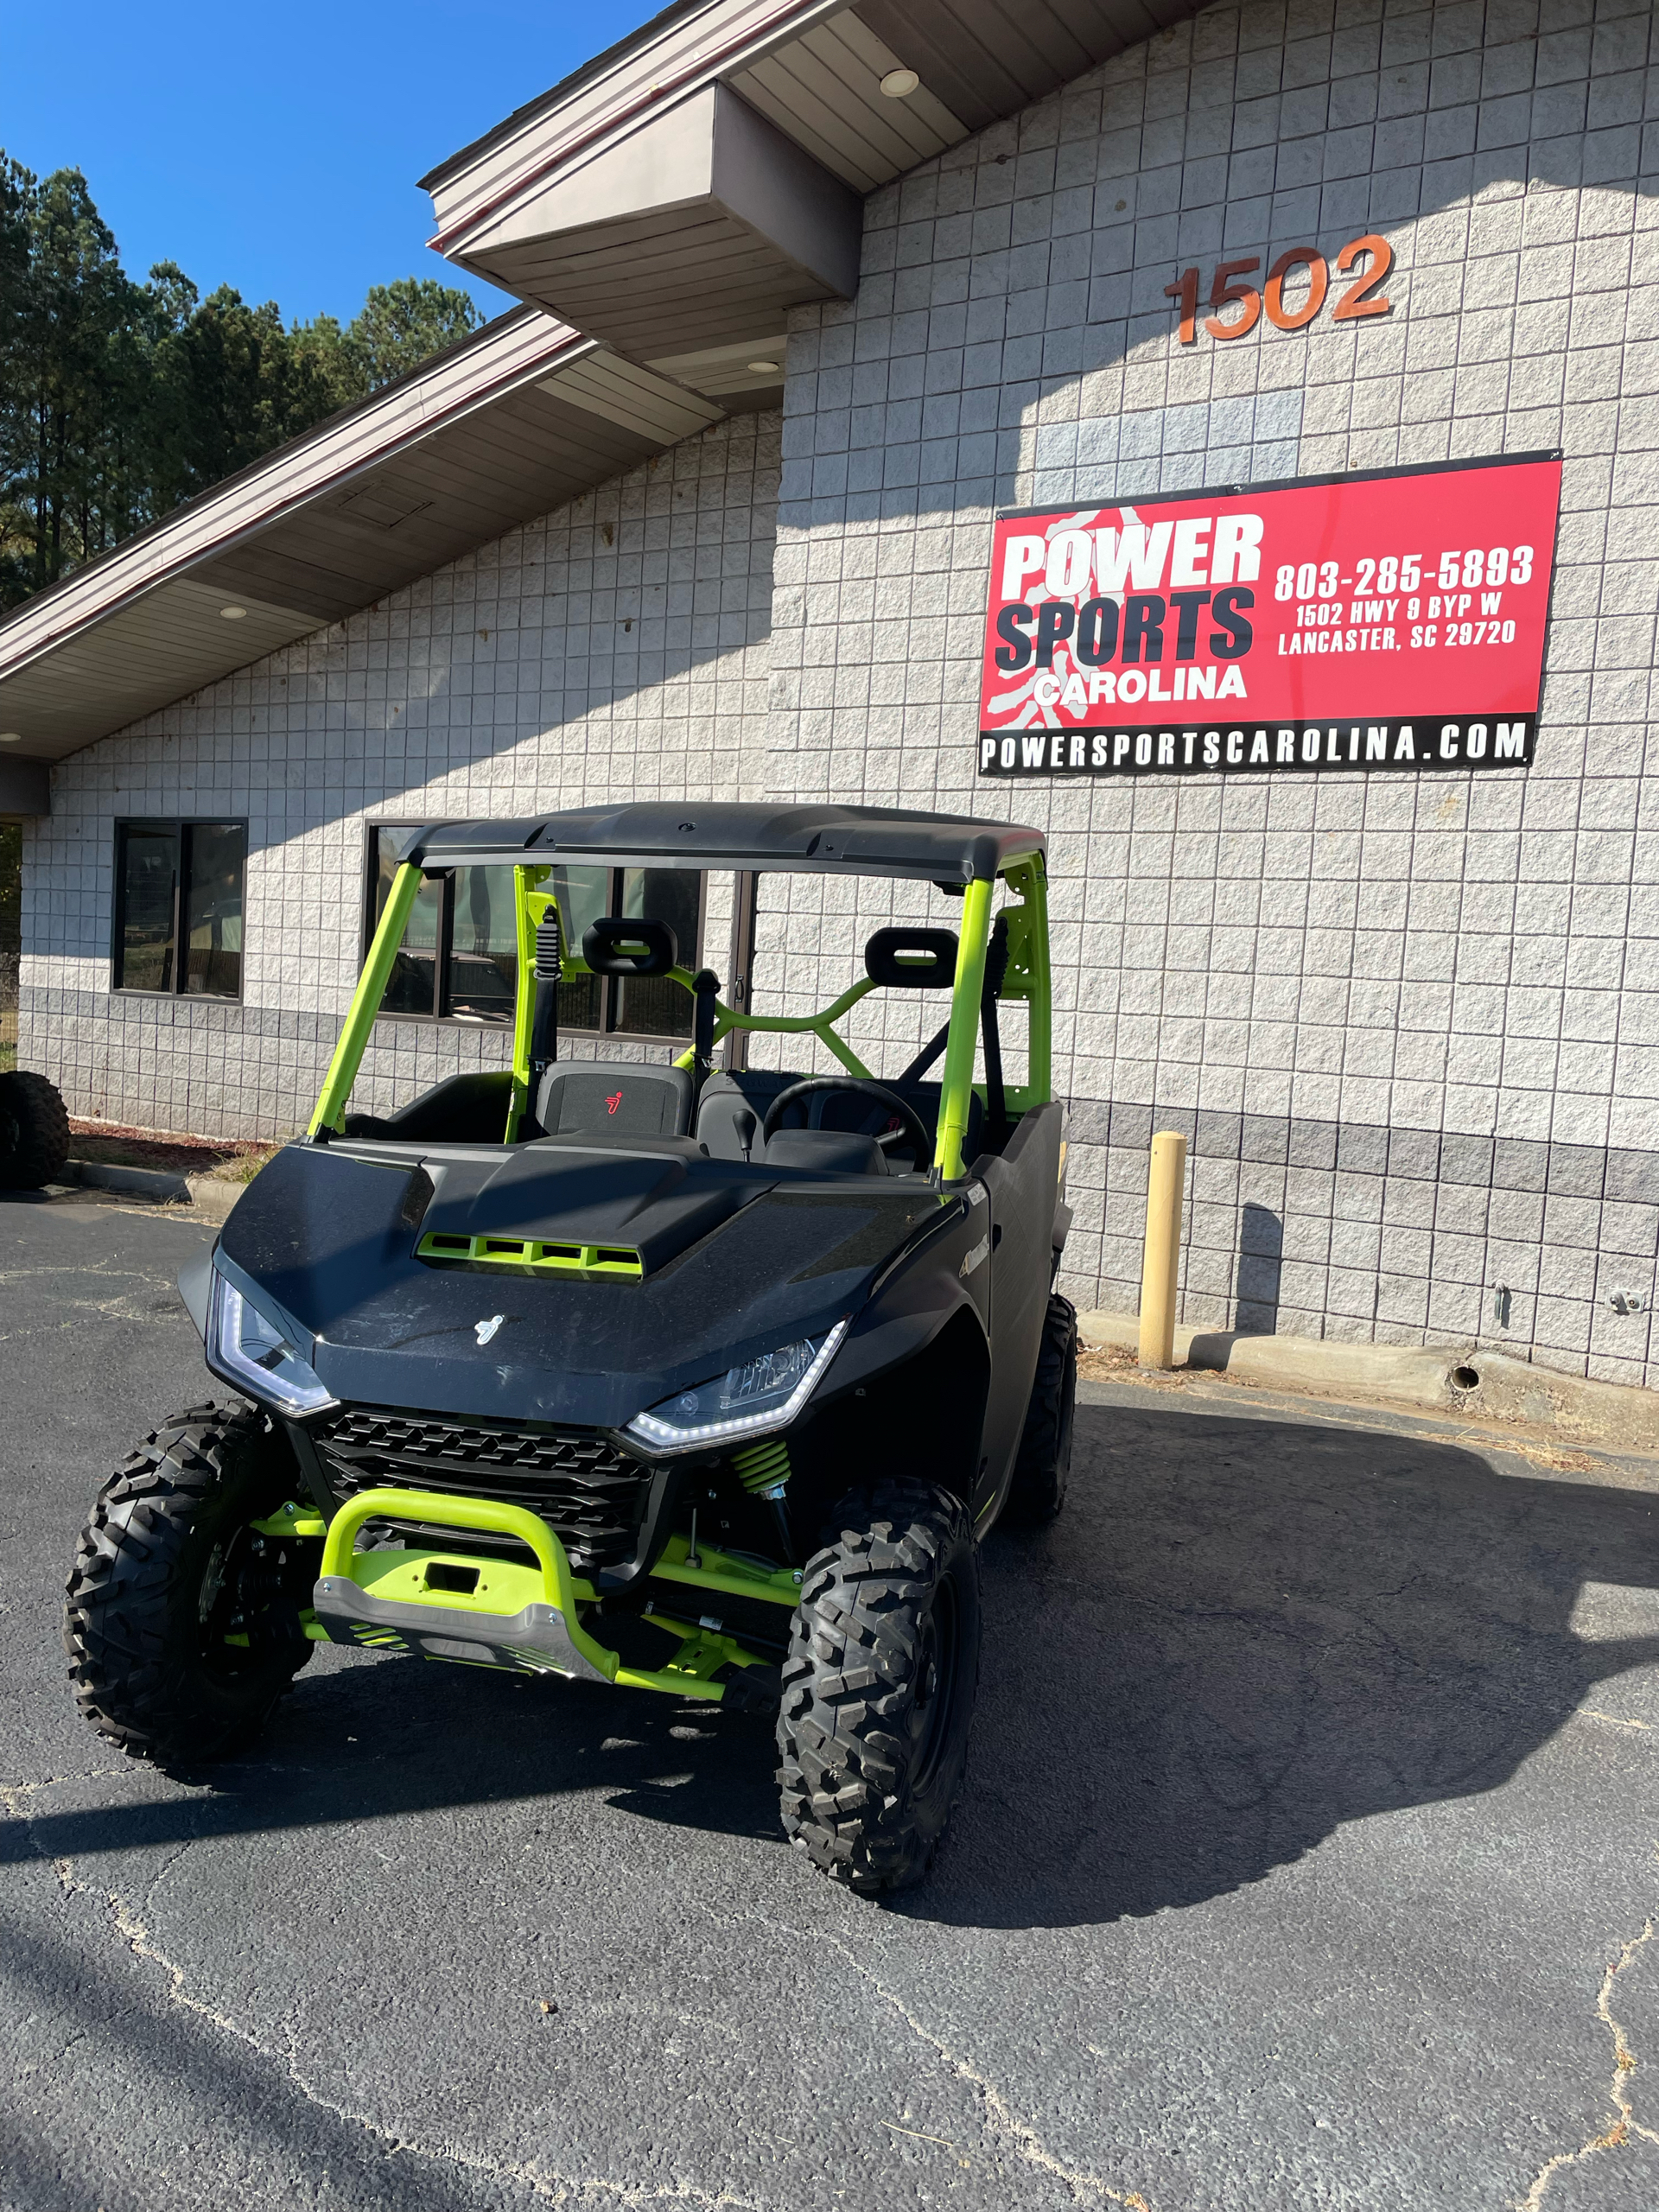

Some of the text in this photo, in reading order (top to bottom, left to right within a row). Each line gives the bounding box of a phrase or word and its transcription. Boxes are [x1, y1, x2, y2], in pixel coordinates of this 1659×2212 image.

[1163, 233, 1392, 343] 1502
[1001, 513, 1264, 601] POWER
[1274, 545, 1534, 601] 803-285-5893
[995, 586, 1255, 671] SPORTS
[1296, 591, 1503, 627] 1502 HWY 9 BYP W
[1278, 620, 1516, 655] LANCASTER, SC 29720
[1033, 664, 1248, 707] CAROLINA
[981, 722, 1526, 768] POWERSPORTSCAROLINA.COM
